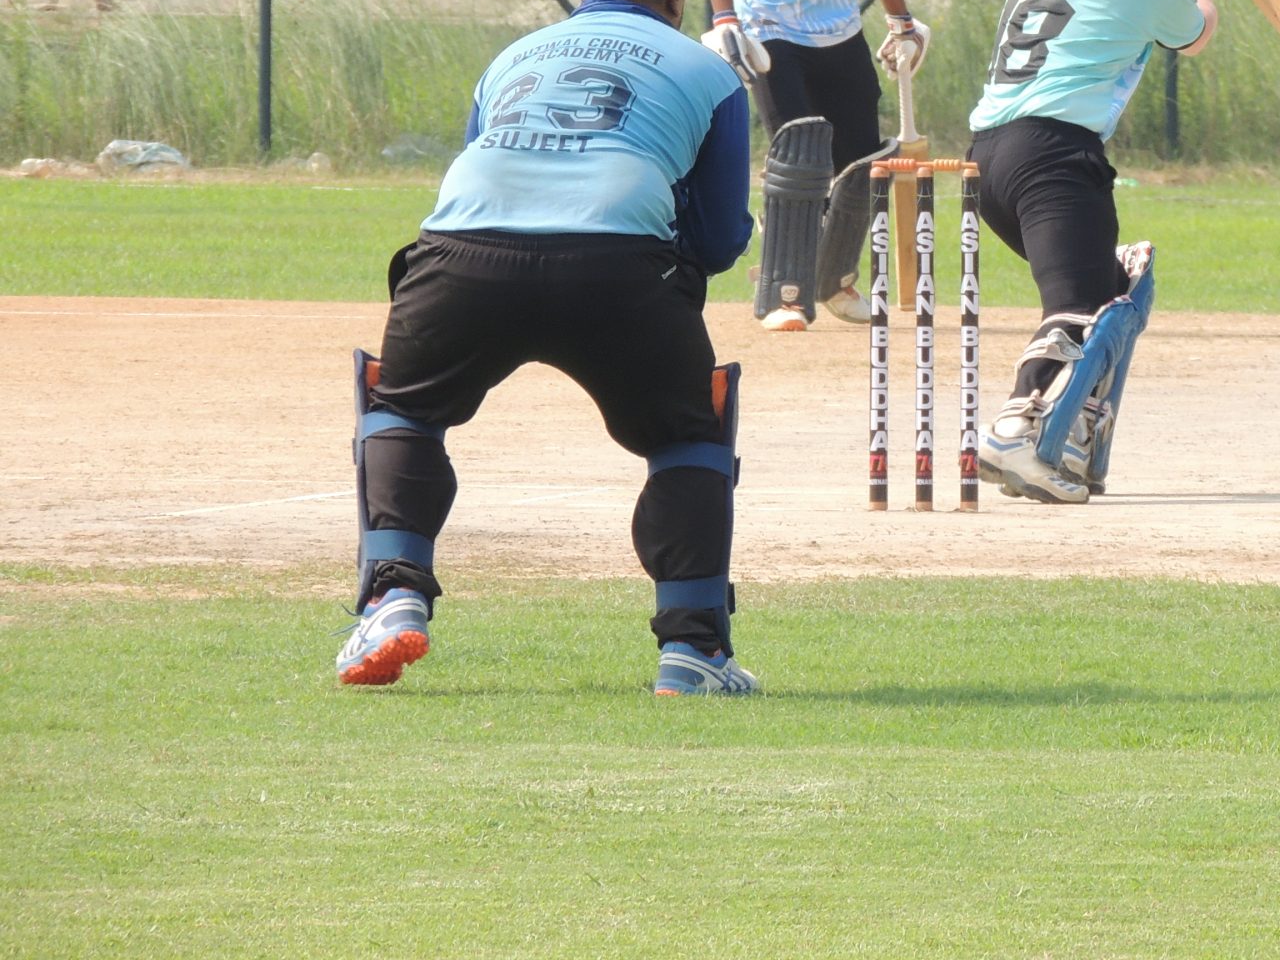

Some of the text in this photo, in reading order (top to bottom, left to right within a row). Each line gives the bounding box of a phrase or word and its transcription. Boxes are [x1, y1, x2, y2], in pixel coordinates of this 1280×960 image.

[489, 64, 637, 132] 23
[535, 47, 624, 64] ACADEMY
[588, 38, 665, 66] CRICKET
[480, 130, 594, 153] SUJEET
[871, 211, 889, 316] ASIAN
[916, 211, 934, 316] ASIAN
[961, 211, 979, 315] ASIAN
[870, 326, 888, 452] BUDDHA
[916, 326, 933, 451] BUDDHA
[961, 326, 978, 451] BUDDHA
